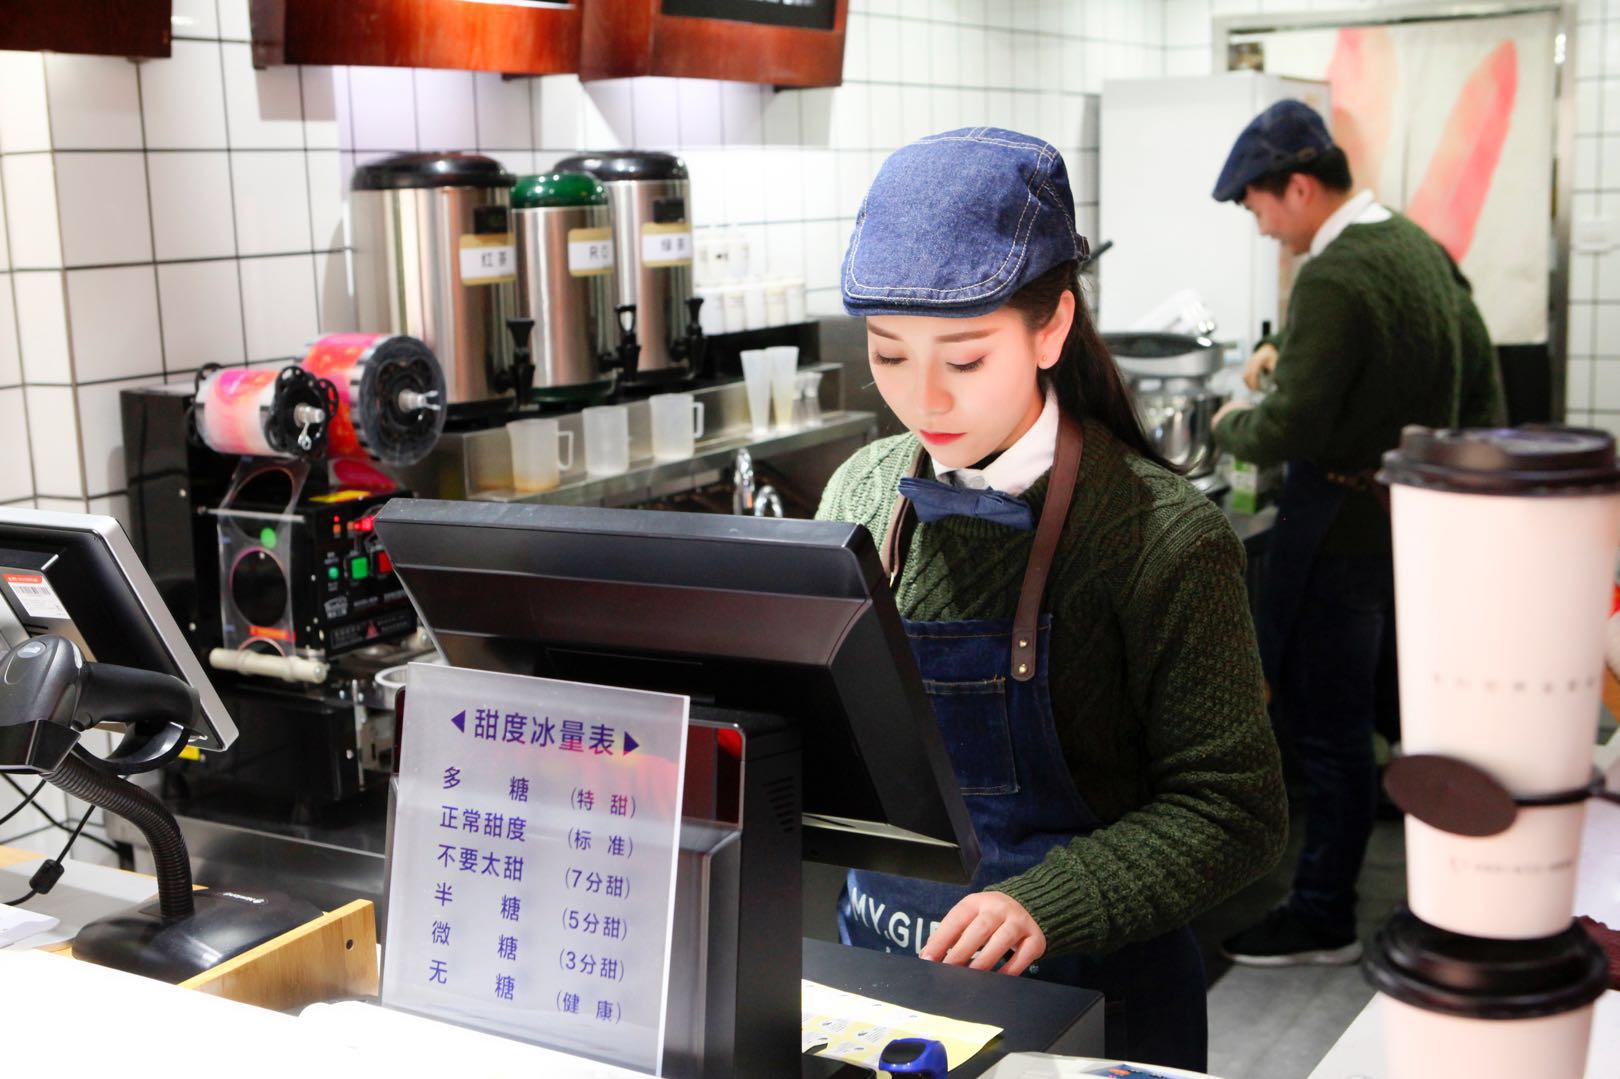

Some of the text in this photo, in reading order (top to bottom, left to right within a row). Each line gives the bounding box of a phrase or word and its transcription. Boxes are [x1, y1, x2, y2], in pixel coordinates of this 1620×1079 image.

[474, 708, 615, 756] 甜度冰量表
[443, 766, 529, 803] 多糖
[440, 805, 527, 842] 正常甜度
[437, 843, 524, 881] 不要太甜
[434, 882, 521, 922] 半糖
[851, 887, 942, 955] MY.GI
[431, 920, 518, 961] 微糖
[429, 959, 516, 1001] 无糖
